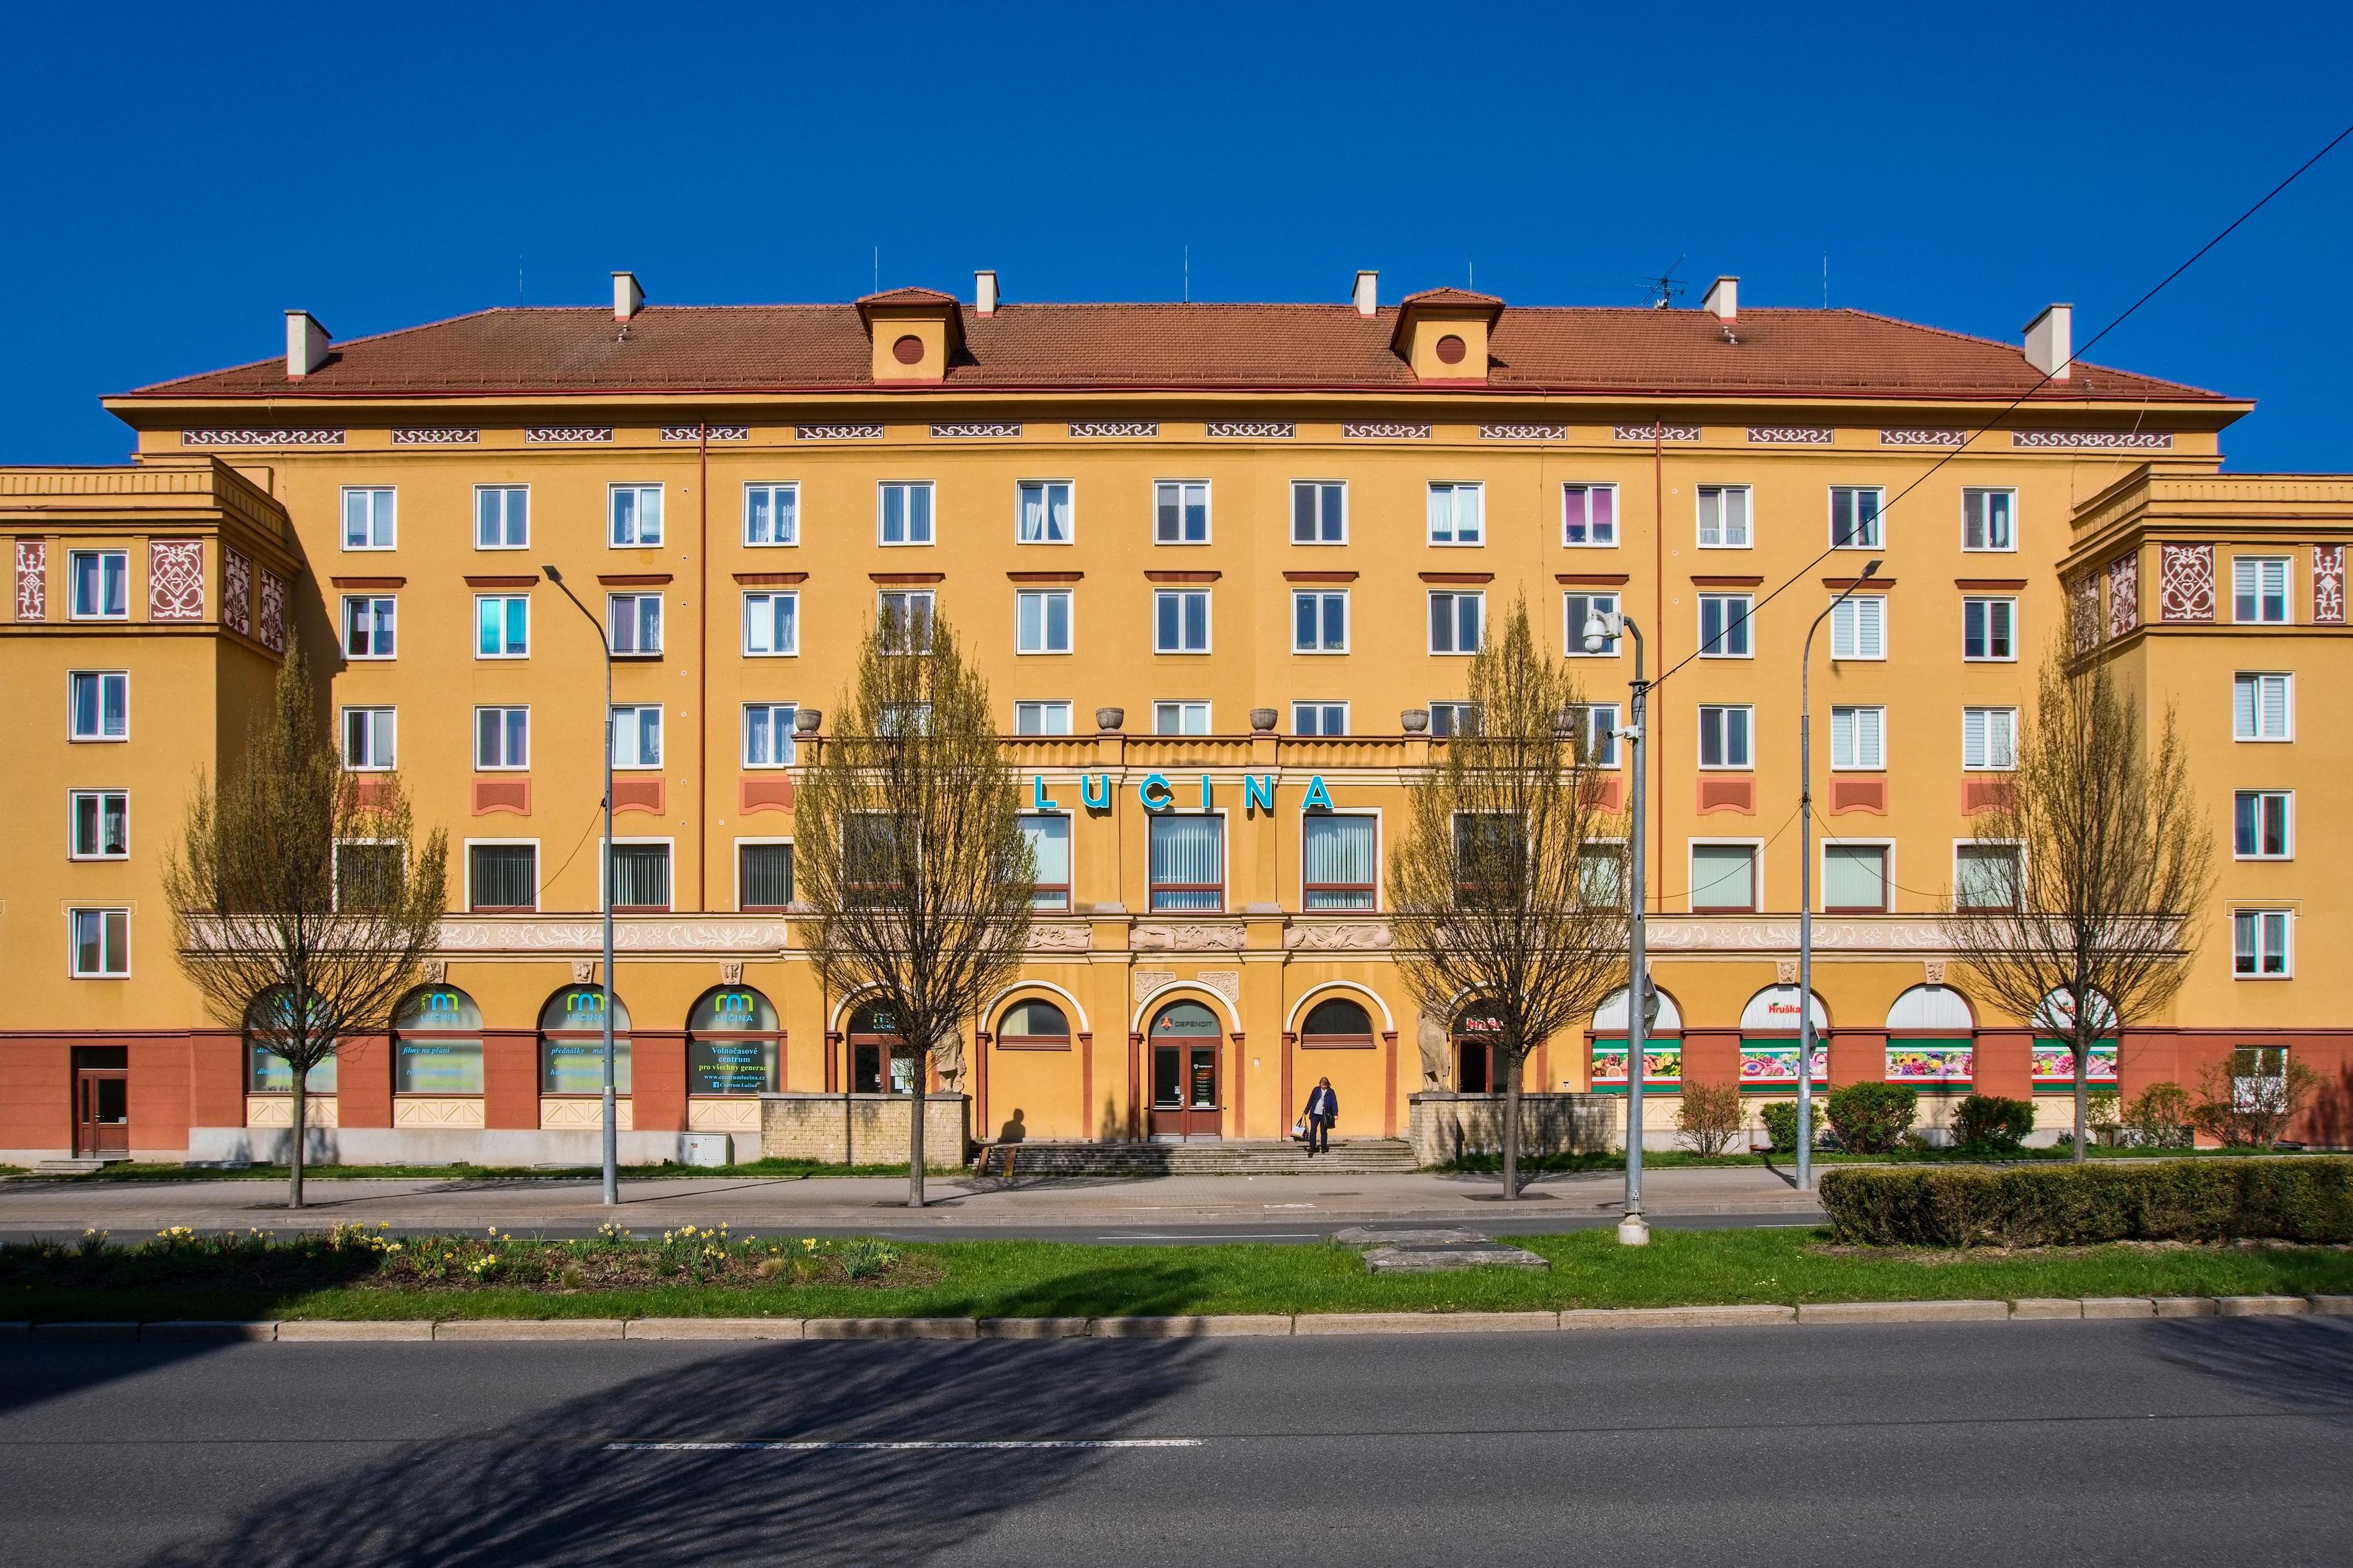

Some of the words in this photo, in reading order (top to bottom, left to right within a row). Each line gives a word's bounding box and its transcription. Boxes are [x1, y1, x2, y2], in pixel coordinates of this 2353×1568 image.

[1034, 773, 1334, 809] LUČINA
[1769, 1005, 1801, 1013] Hruška
[567, 1013, 604, 1021] LUČINA
[402, 1047, 420, 1055] filmy
[712, 1063, 739, 1072] všechny
